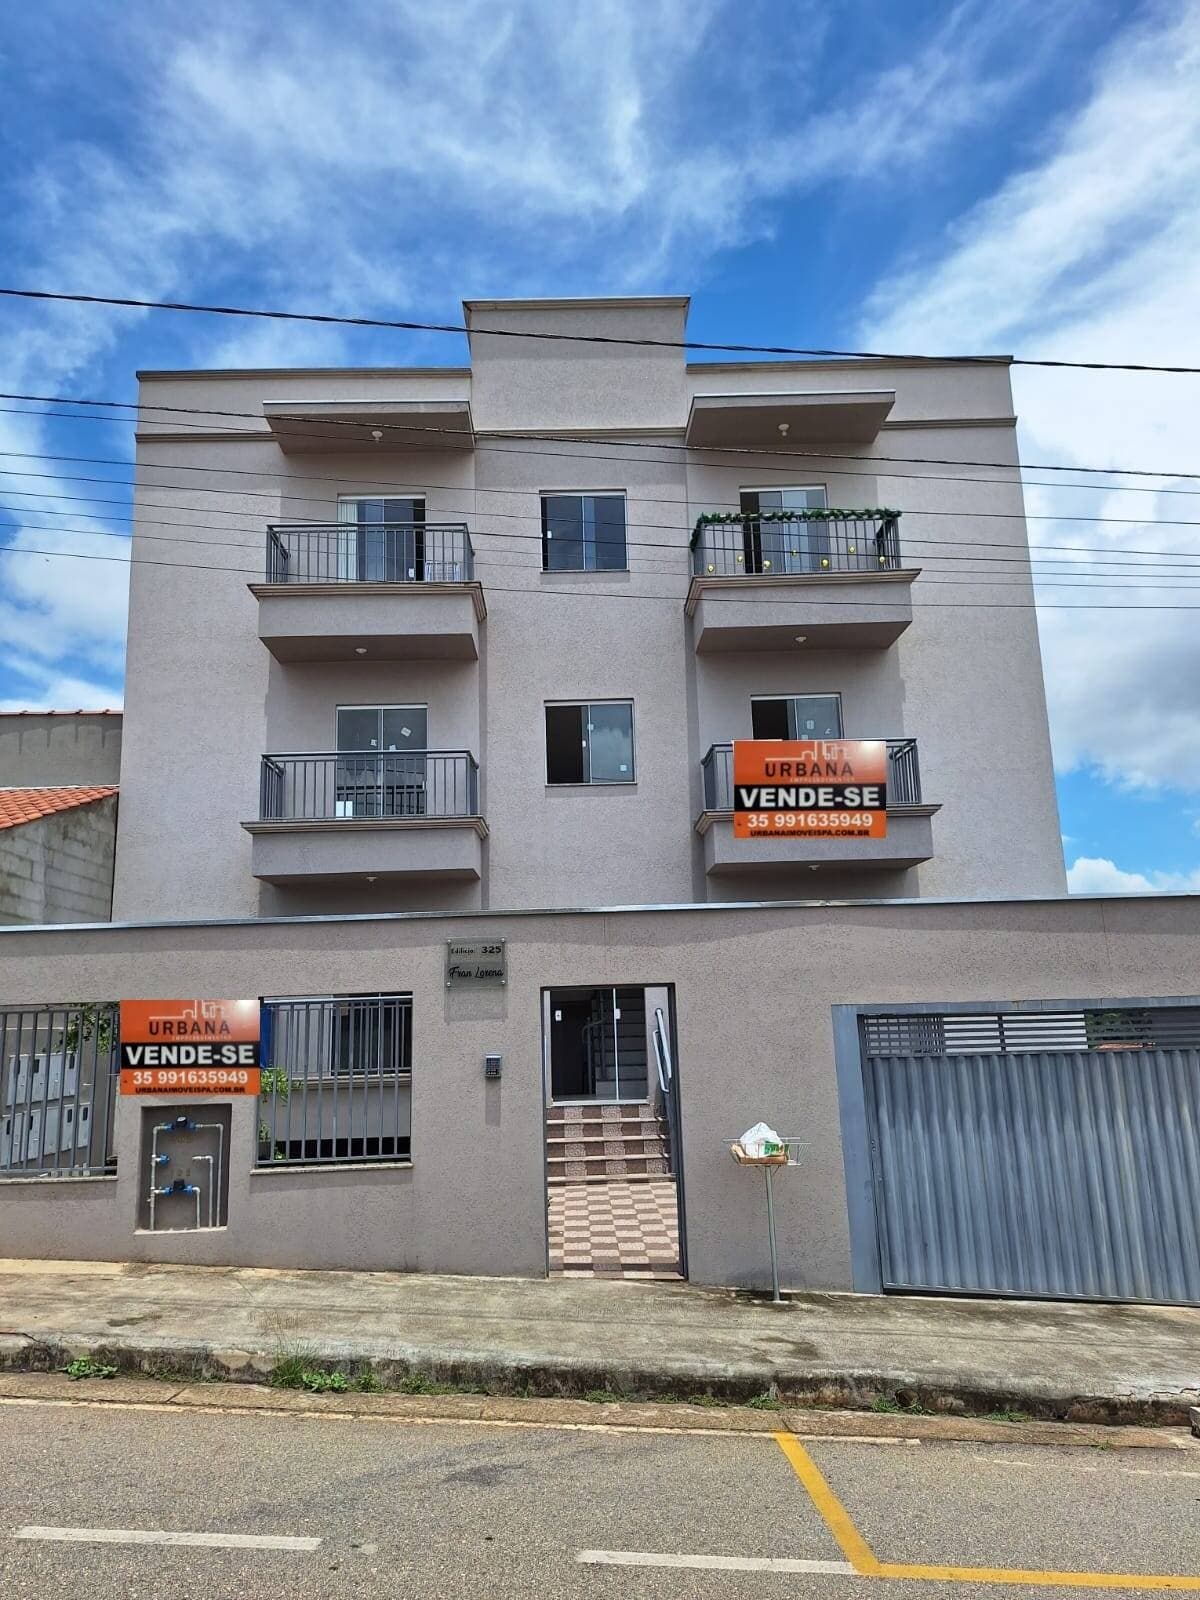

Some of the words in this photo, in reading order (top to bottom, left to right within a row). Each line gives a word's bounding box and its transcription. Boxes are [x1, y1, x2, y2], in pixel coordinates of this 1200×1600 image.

[765, 762, 854, 777] URBANA
[739, 786, 880, 808] VENDE-SE
[747, 814, 769, 827] 35
[774, 813, 873, 827] 991635949
[750, 829, 870, 837] URBANAIMOVEISPA.COM.BR
[481, 945, 502, 954] 325
[448, 966, 472, 980] Fran
[474, 965, 504, 979] Lorena
[149, 1021, 231, 1035] URBANA
[126, 1044, 255, 1065] VENDE-SE
[133, 1071, 152, 1085] 35
[157, 1070, 248, 1085] 991635949
[135, 1086, 245, 1094] URBANAIMOVEISPA.COM.BR
